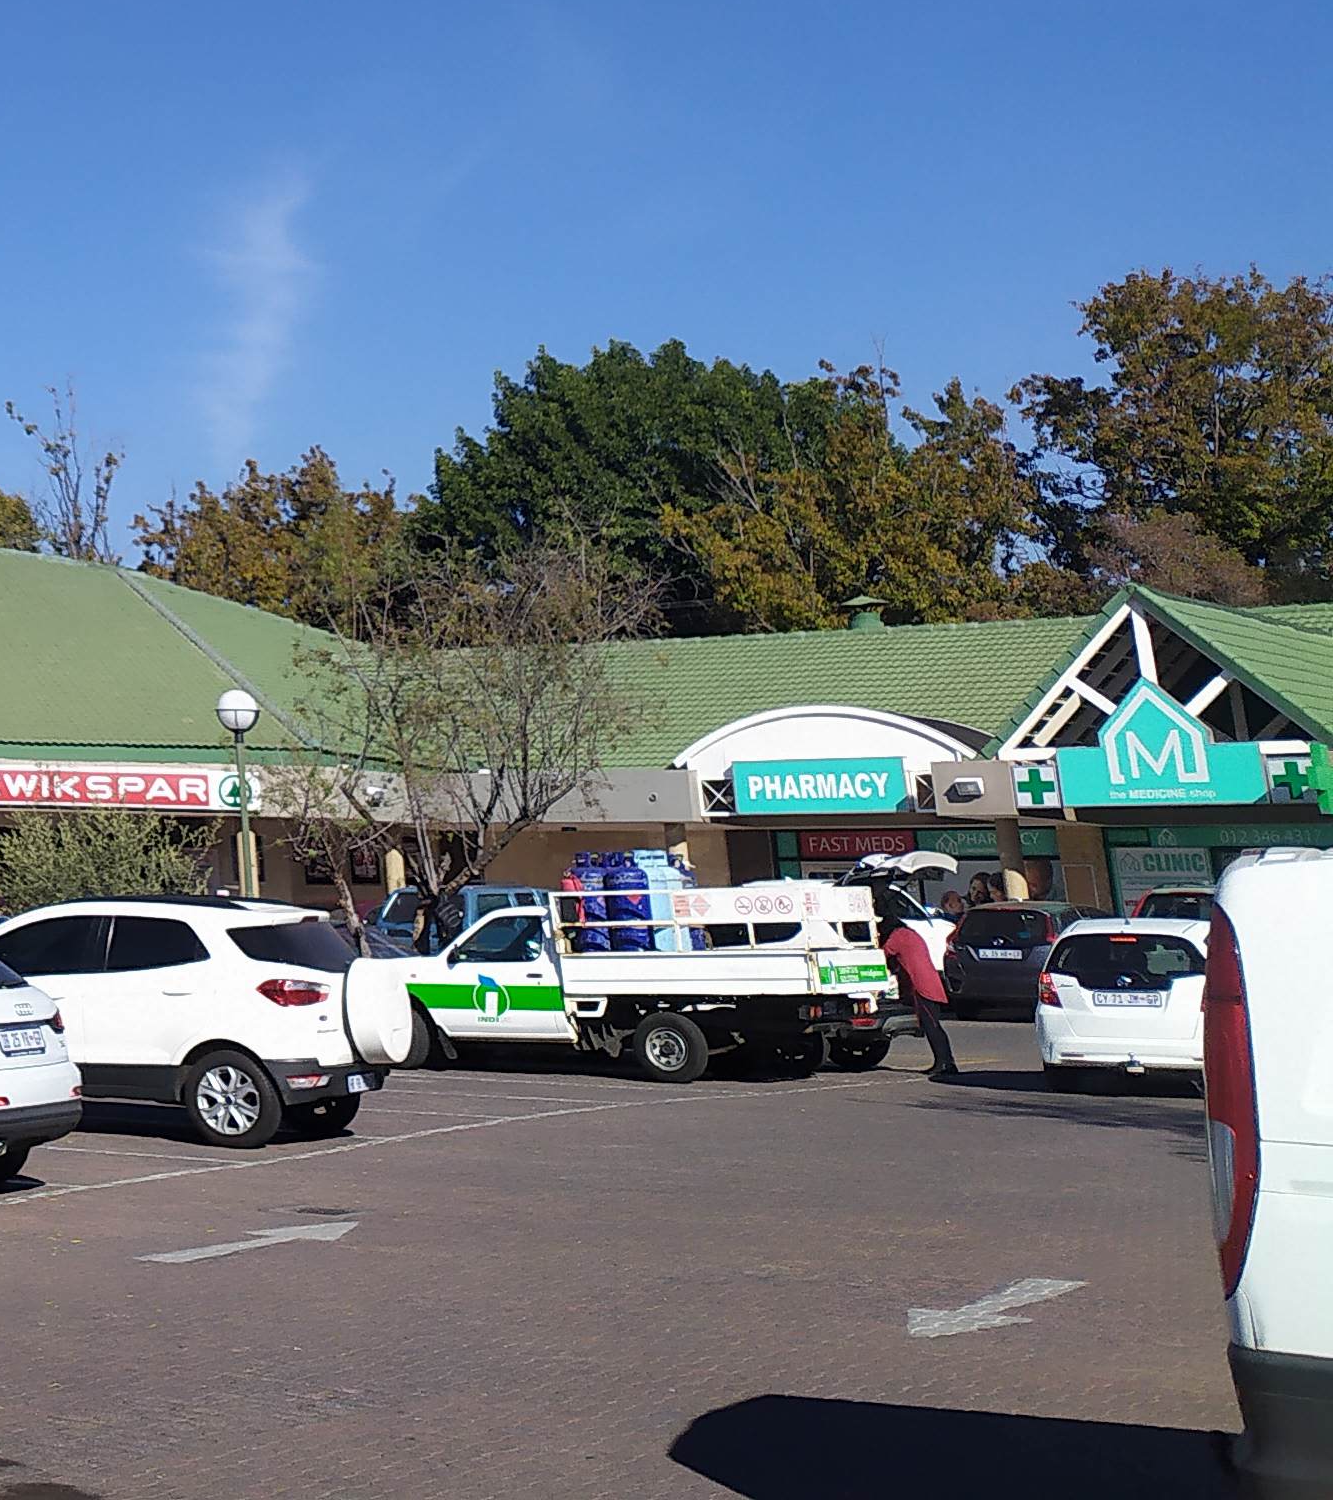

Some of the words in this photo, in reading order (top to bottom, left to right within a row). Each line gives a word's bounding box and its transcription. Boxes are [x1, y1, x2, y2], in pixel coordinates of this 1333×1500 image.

[747, 772, 889, 800] PHARMACY
[1108, 790, 1126, 799] the
[1129, 789, 1187, 799] MEDICINE
[1189, 788, 1217, 801] shop
[808, 836, 850, 853] FAST
[855, 835, 906, 852] MEDS
[957, 832, 1040, 845] PHARCY
[1220, 829, 1247, 844] 012
[1142, 853, 1206, 872] CLINIC
